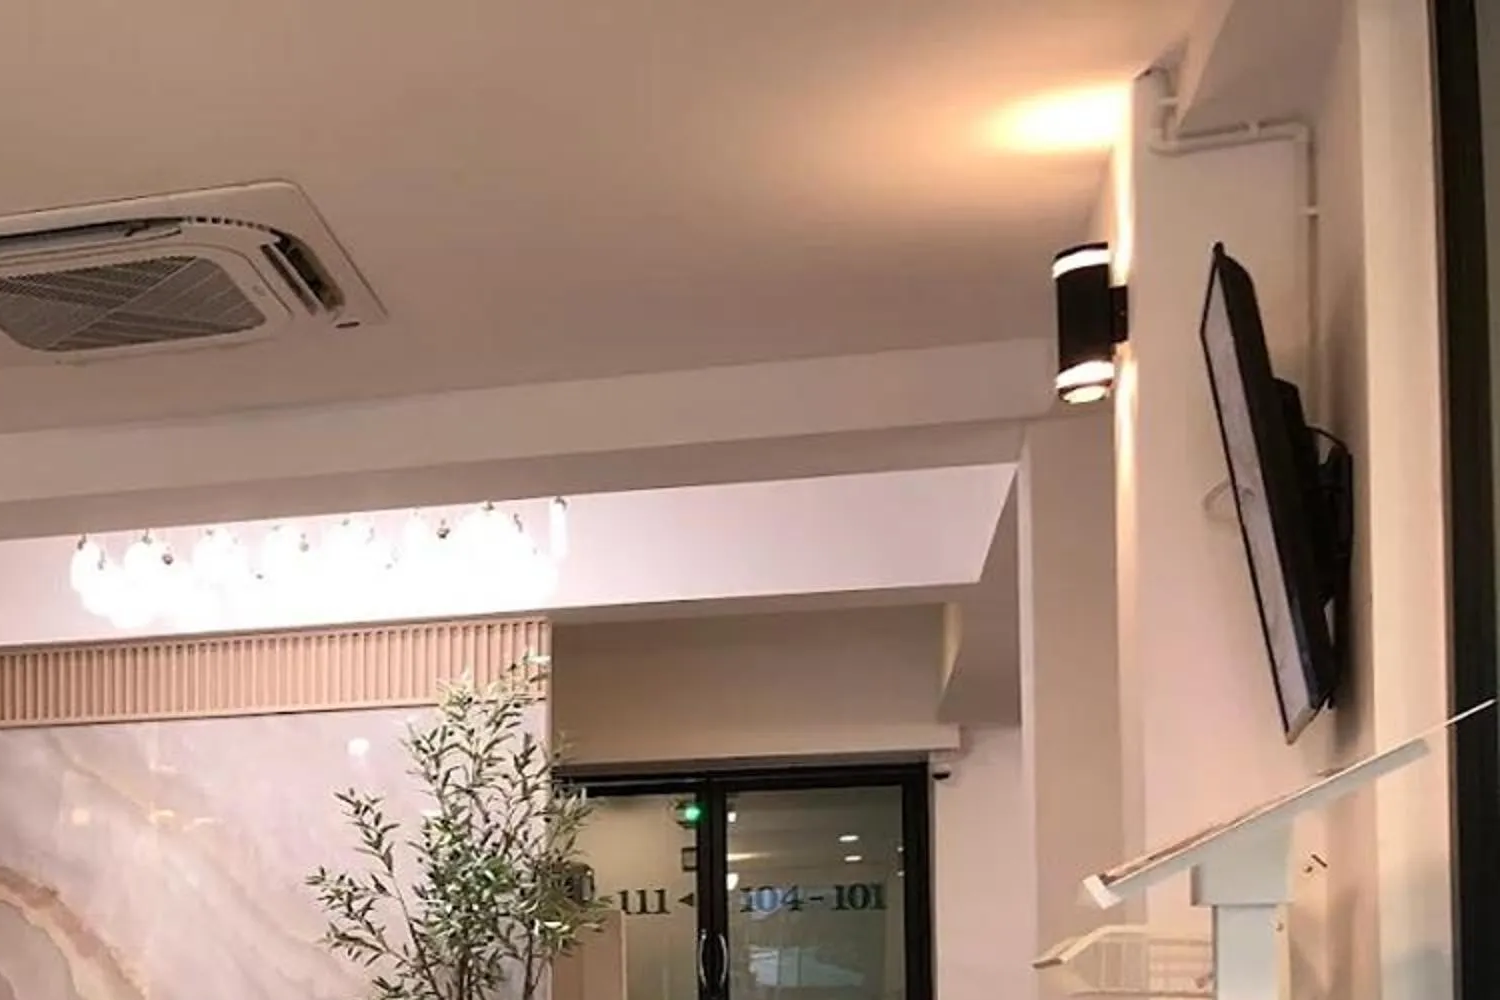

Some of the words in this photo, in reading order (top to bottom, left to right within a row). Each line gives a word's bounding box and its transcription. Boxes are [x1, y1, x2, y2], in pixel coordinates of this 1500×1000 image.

[618, 888, 671, 914] 111
[740, 886, 804, 912] 104
[833, 882, 887, 910] 101
